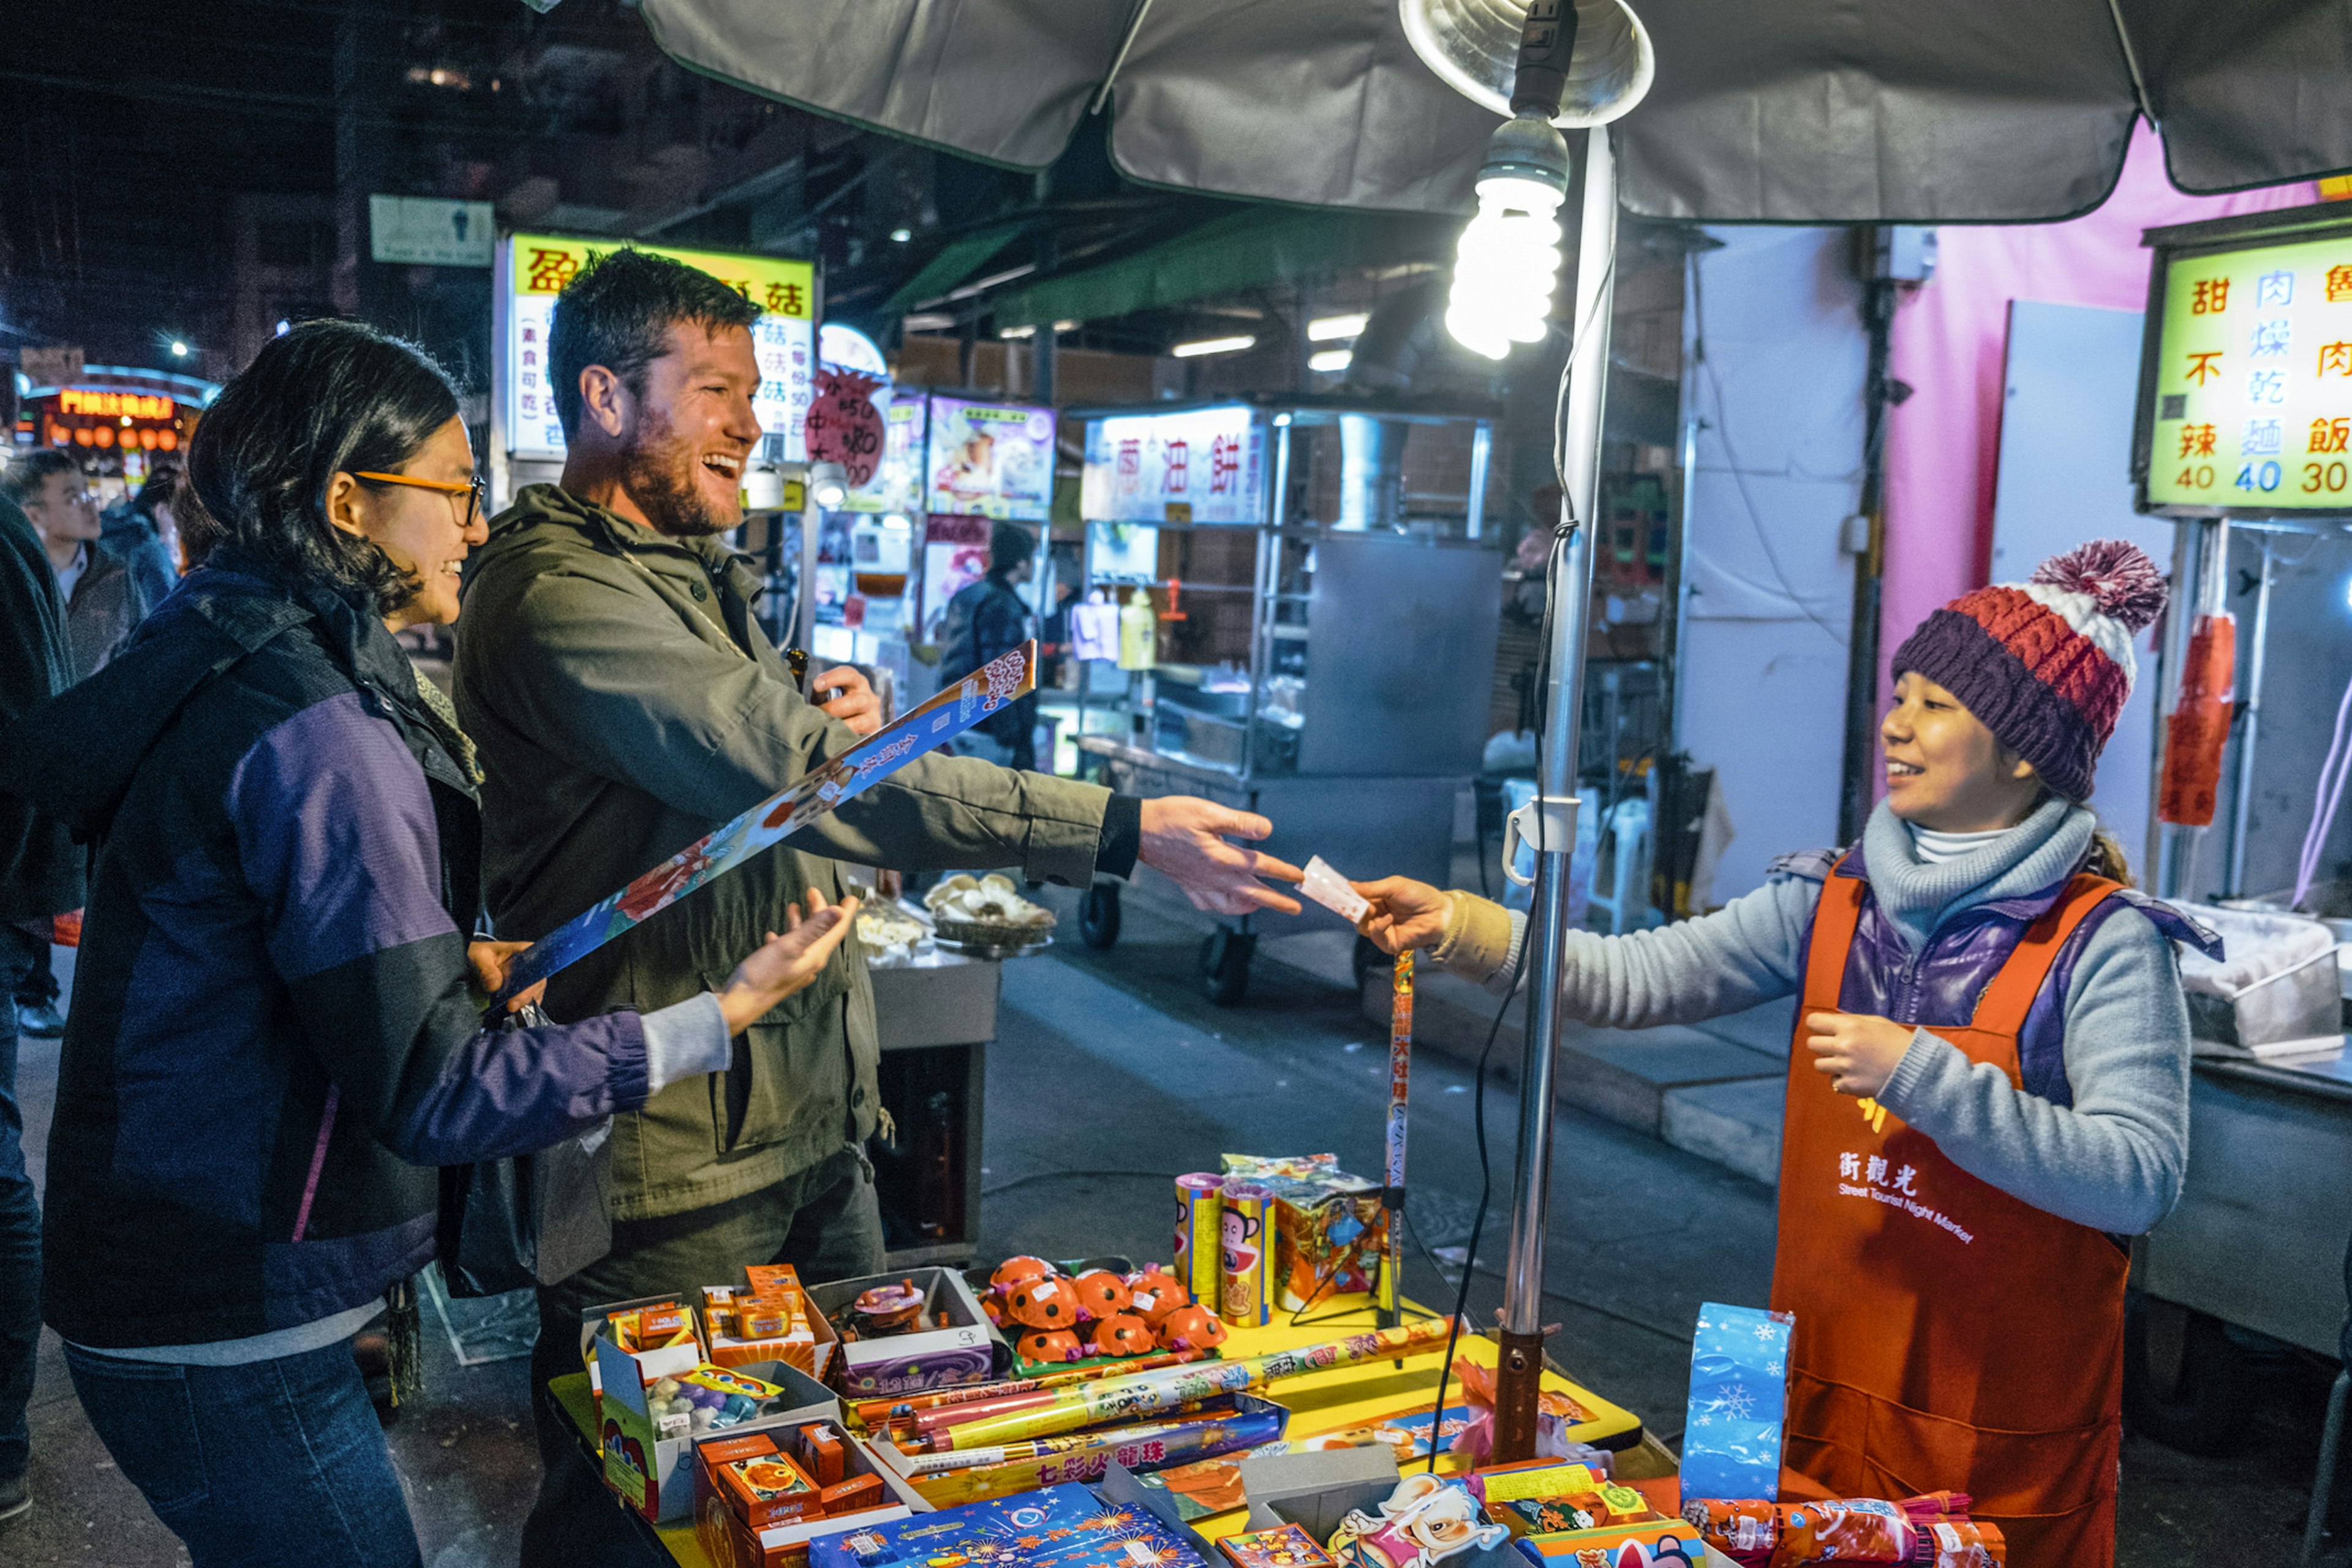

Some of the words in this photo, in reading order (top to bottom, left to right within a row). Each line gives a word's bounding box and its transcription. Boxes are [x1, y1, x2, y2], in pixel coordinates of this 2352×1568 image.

[2179, 277, 2230, 460] 甜不辣
[808, 409, 826, 438] 中
[2176, 465, 2215, 489] 40
[2234, 461, 2282, 492] 40
[2301, 462, 2348, 492] 30
[1838, 1151, 1917, 1197] 街觀光
[1838, 1183, 1868, 1197] Street
[1870, 1187, 1904, 1208] Tourist
[1904, 1199, 1934, 1221] Night
[1933, 1212, 1974, 1245] Market
[1035, 1439, 1166, 1484] 七彩火龍珠
[768, 1502, 804, 1518] 24PCS
